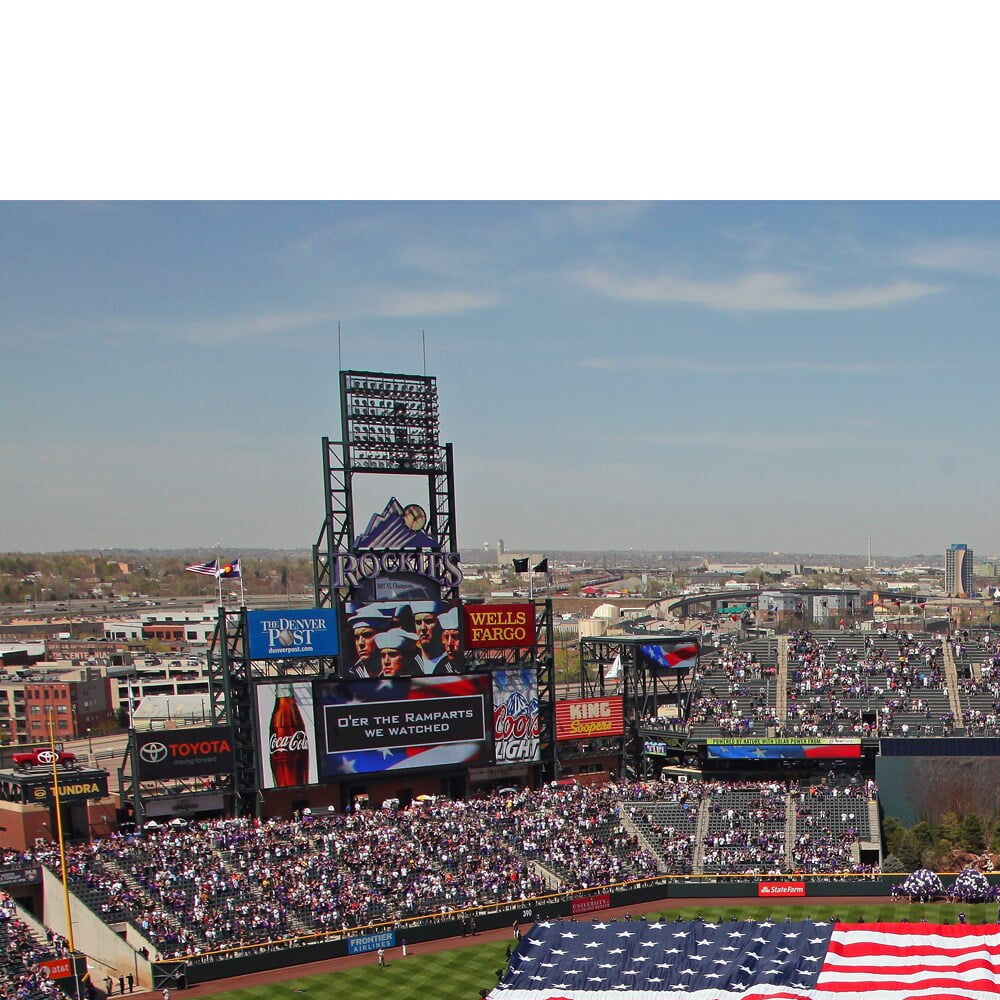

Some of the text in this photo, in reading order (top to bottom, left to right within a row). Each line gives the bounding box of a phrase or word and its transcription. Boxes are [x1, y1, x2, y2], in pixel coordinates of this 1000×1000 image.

[332, 552, 464, 589] ROCKIES
[260, 618, 327, 631] THE DENVER
[469, 611, 527, 626] WELLS
[471, 628, 527, 642] FARGO
[268, 646, 314, 655] denverpost.com
[569, 701, 611, 720] KING
[338, 714, 369, 728] O'ER
[374, 714, 400, 725] THE
[492, 704, 544, 741] Coors
[570, 720, 612, 736] Soopers
[364, 723, 450, 738] WE WATCHED
[169, 740, 231, 757] TOYOTA
[269, 730, 309, 752] Coca-Cola
[495, 737, 540, 762] LIGHT
[50, 783, 100, 797] TUNDRA
[350, 932, 393, 947] FRONTIER
[353, 939, 392, 953] AIRLINES
[51, 963, 70, 974] at&t
